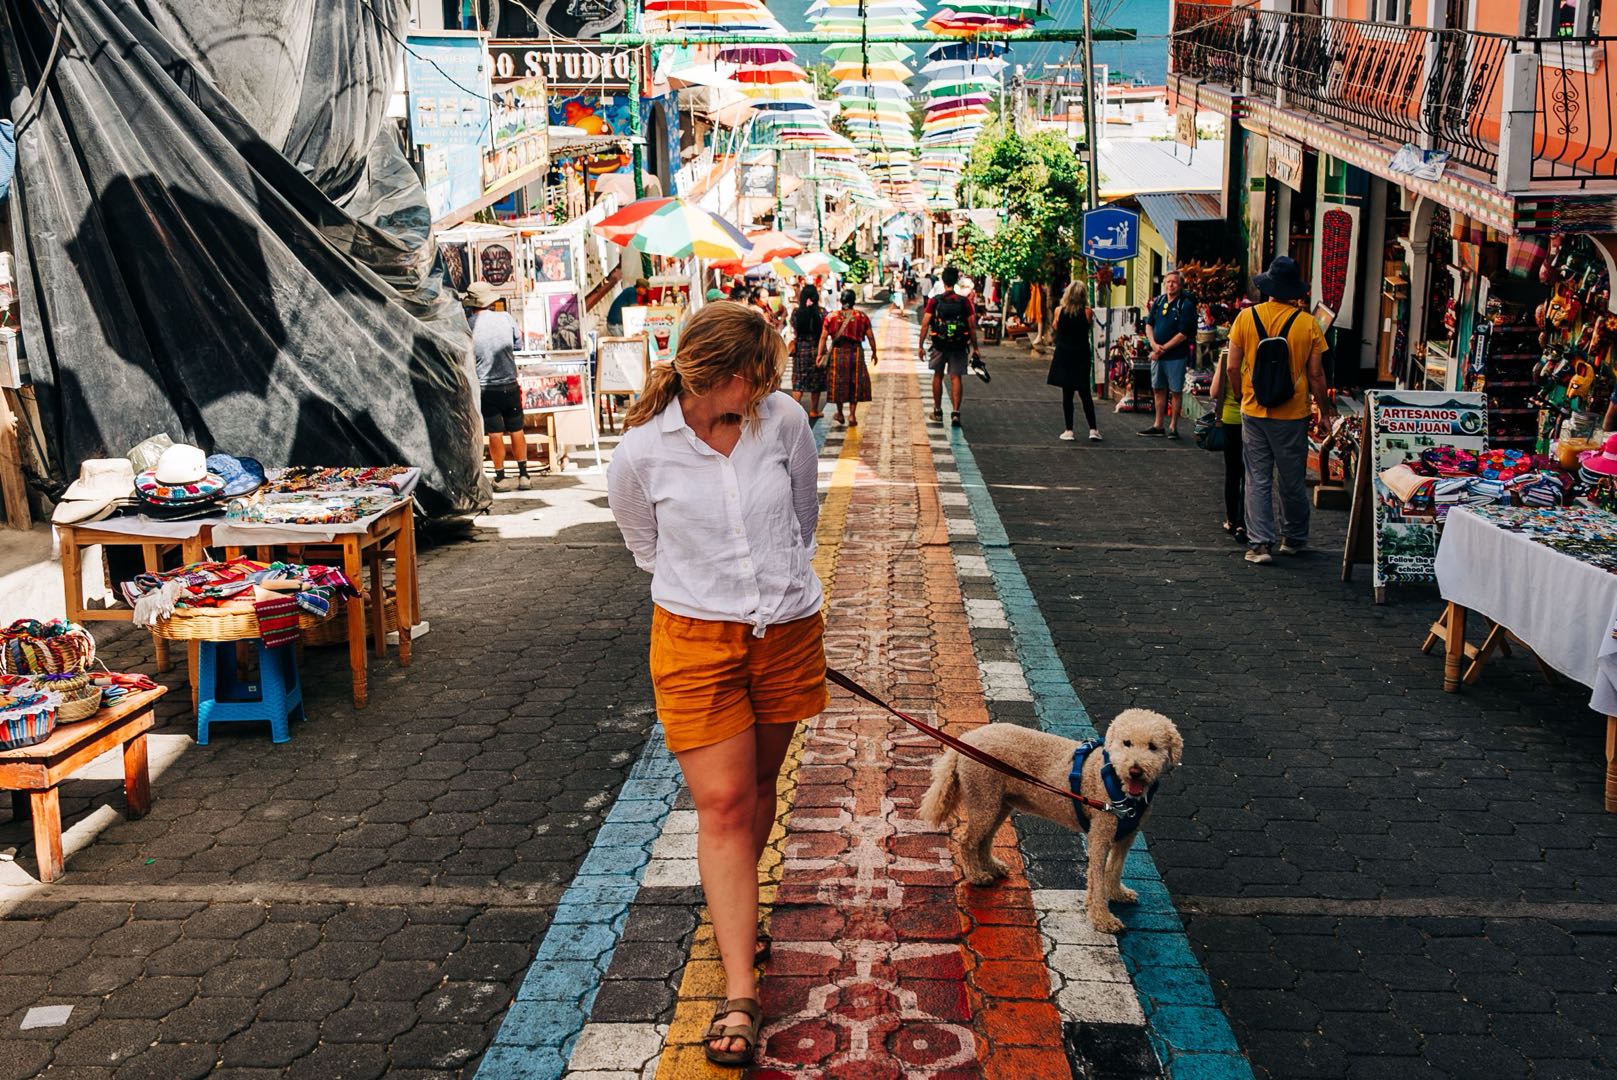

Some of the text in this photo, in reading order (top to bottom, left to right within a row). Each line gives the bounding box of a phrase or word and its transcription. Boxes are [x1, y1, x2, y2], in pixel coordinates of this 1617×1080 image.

[524, 51, 629, 79] STUDIO
[1382, 408, 1458, 420] ARTESANOS
[1389, 421, 1415, 432] SAN
[1417, 422, 1451, 433] JUAN
[1388, 555, 1414, 563] Follow
